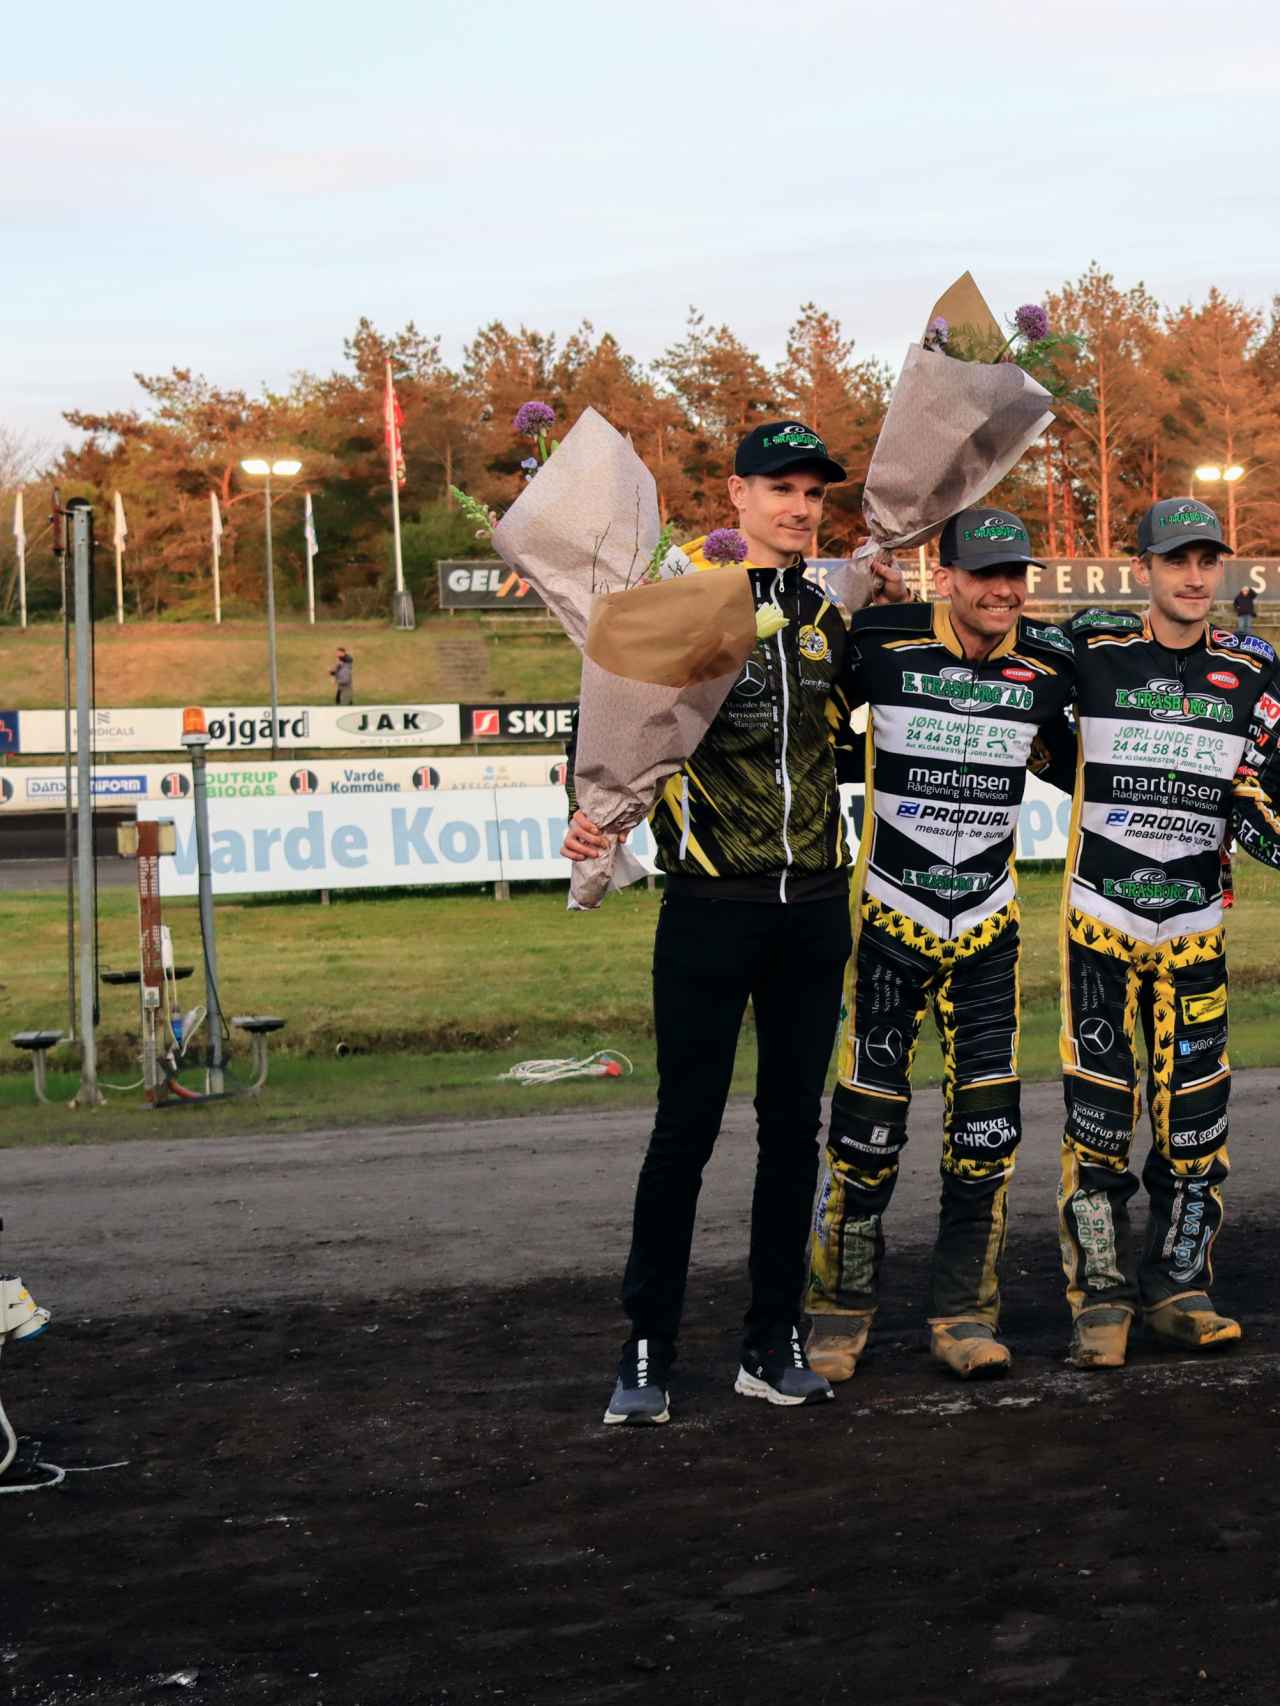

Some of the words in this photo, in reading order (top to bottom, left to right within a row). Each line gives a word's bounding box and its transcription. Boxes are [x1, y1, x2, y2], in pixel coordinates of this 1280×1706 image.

[1026, 565, 1132, 594] FERI
[207, 711, 310, 745] øjgård
[508, 710, 573, 737] SKJE
[907, 714, 985, 736] JØRLUNDE
[988, 726, 1017, 740] BYG
[906, 729, 921, 741] 24
[924, 731, 941, 744] 44
[945, 734, 961, 747] 58
[1112, 739, 1129, 752] 24
[1131, 741, 1148, 754] 44
[1152, 743, 1169, 756] 58
[1172, 745, 1189, 758] 45
[1114, 726, 1193, 747] JØRLUNDE
[1196, 735, 1224, 751] BYG
[331, 781, 400, 793] Kommune
[344, 769, 384, 782] Varde
[908, 767, 1010, 791] martinsen
[1113, 772, 1221, 802] martinsen
[920, 805, 1010, 826] PRODUAL
[967, 1117, 1010, 1132] NIKKEL
